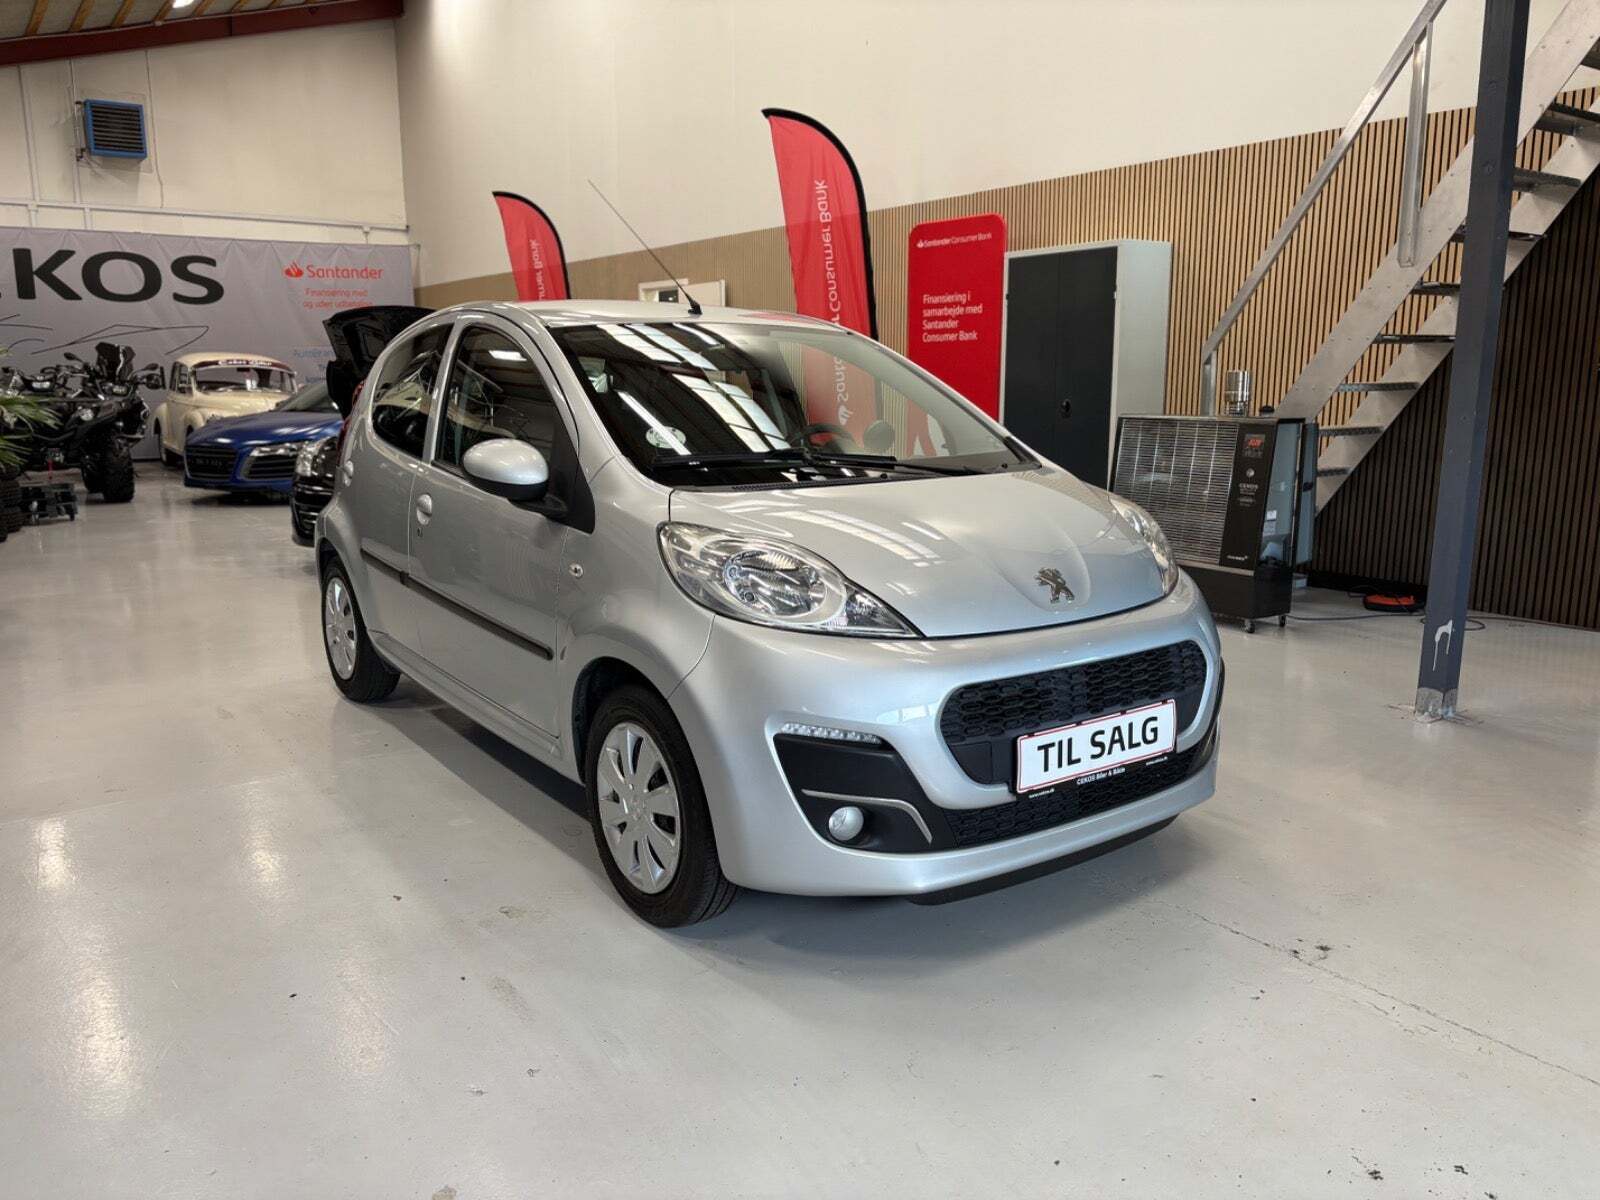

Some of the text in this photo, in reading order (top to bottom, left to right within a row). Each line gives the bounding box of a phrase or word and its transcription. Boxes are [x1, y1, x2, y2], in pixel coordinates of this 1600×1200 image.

[0, 248, 225, 305] KOS
[306, 264, 384, 280] Santander
[923, 292, 967, 305] Finansiering
[922, 302, 983, 318] samarbejde med
[922, 318, 960, 331] Santander
[922, 329, 978, 343] Consumer Bank
[1037, 716, 1159, 773] TIL SALG
[1076, 773, 1096, 786] CEKOS
